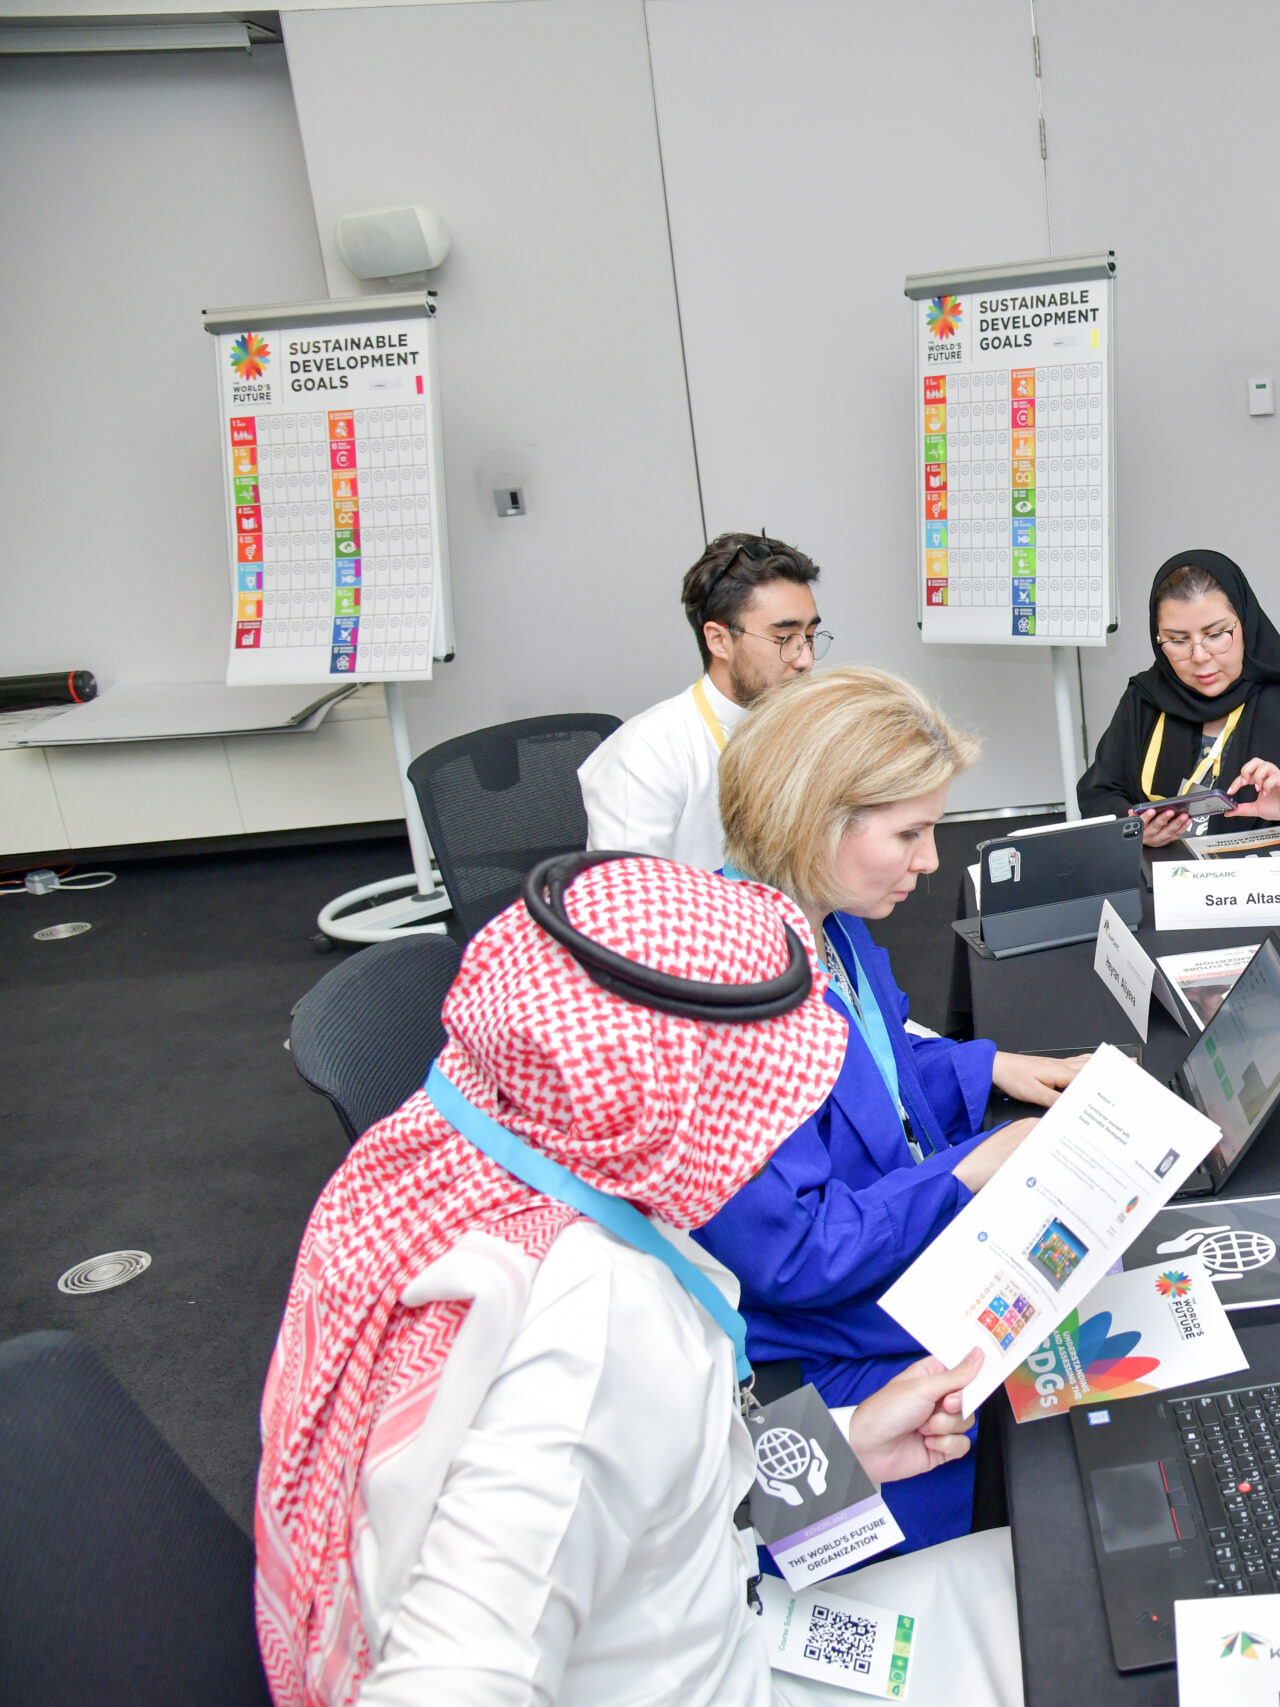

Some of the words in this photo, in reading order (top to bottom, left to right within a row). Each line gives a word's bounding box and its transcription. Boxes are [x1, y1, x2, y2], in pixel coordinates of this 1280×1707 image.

[979, 290, 1089, 314] SUSTAINABLE
[979, 308, 1099, 332] DEVELOPMENT
[289, 333, 408, 356] SUSTAINABLE
[928, 343, 962, 352] WORLD'S
[980, 333, 1033, 351] GOALS
[290, 351, 419, 374] DEVELOPMENT
[928, 351, 962, 362] FUTURE
[233, 384, 271, 393] WORLD'S
[291, 375, 349, 392] GOALS
[233, 391, 272, 402] FUTURE
[1192, 871, 1237, 879] KAPSARC
[1205, 894, 1238, 907] Sara
[1105, 954, 1120, 984] Heyran
[1182, 963, 1222, 973] FUTURE
[1194, 955, 1253, 968] ANIZATION
[1172, 1300, 1196, 1340] FUTURE
[1183, 1298, 1204, 1337] WORLD'S
[1058, 1345, 1077, 1386] ASSESSING
[1071, 1384, 1082, 1400] THE
[1063, 1330, 1090, 1394] UNDERSTANDING
[788, 1554, 808, 1568] THE
[807, 1534, 850, 1560] WORLD'S
[849, 1517, 887, 1540] FUTURE
[807, 1533, 878, 1571] ORGANIZATION
[778, 1628, 789, 1651] Course
